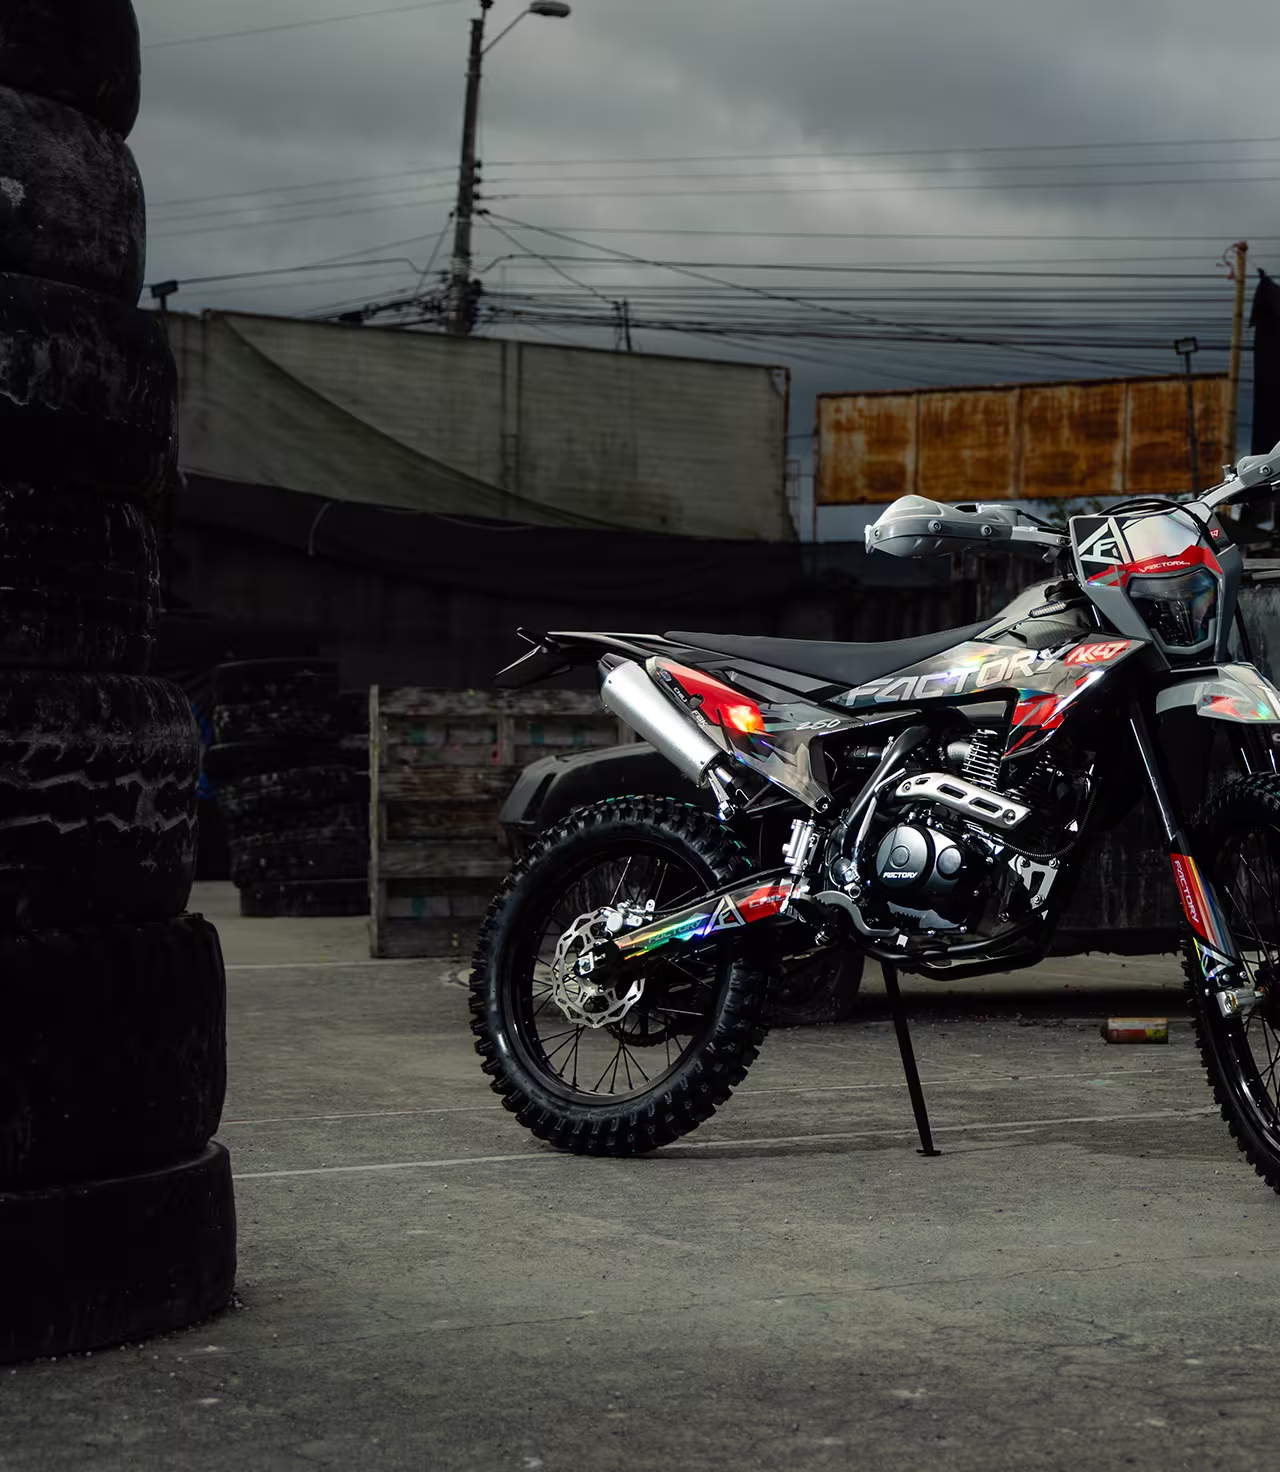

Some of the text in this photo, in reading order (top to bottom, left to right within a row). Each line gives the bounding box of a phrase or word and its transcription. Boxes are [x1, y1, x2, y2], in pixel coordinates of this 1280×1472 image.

[845, 642, 1076, 706] FACTORY
[883, 871, 918, 879] FACTORY
[1174, 859, 1199, 923] FACTORY
